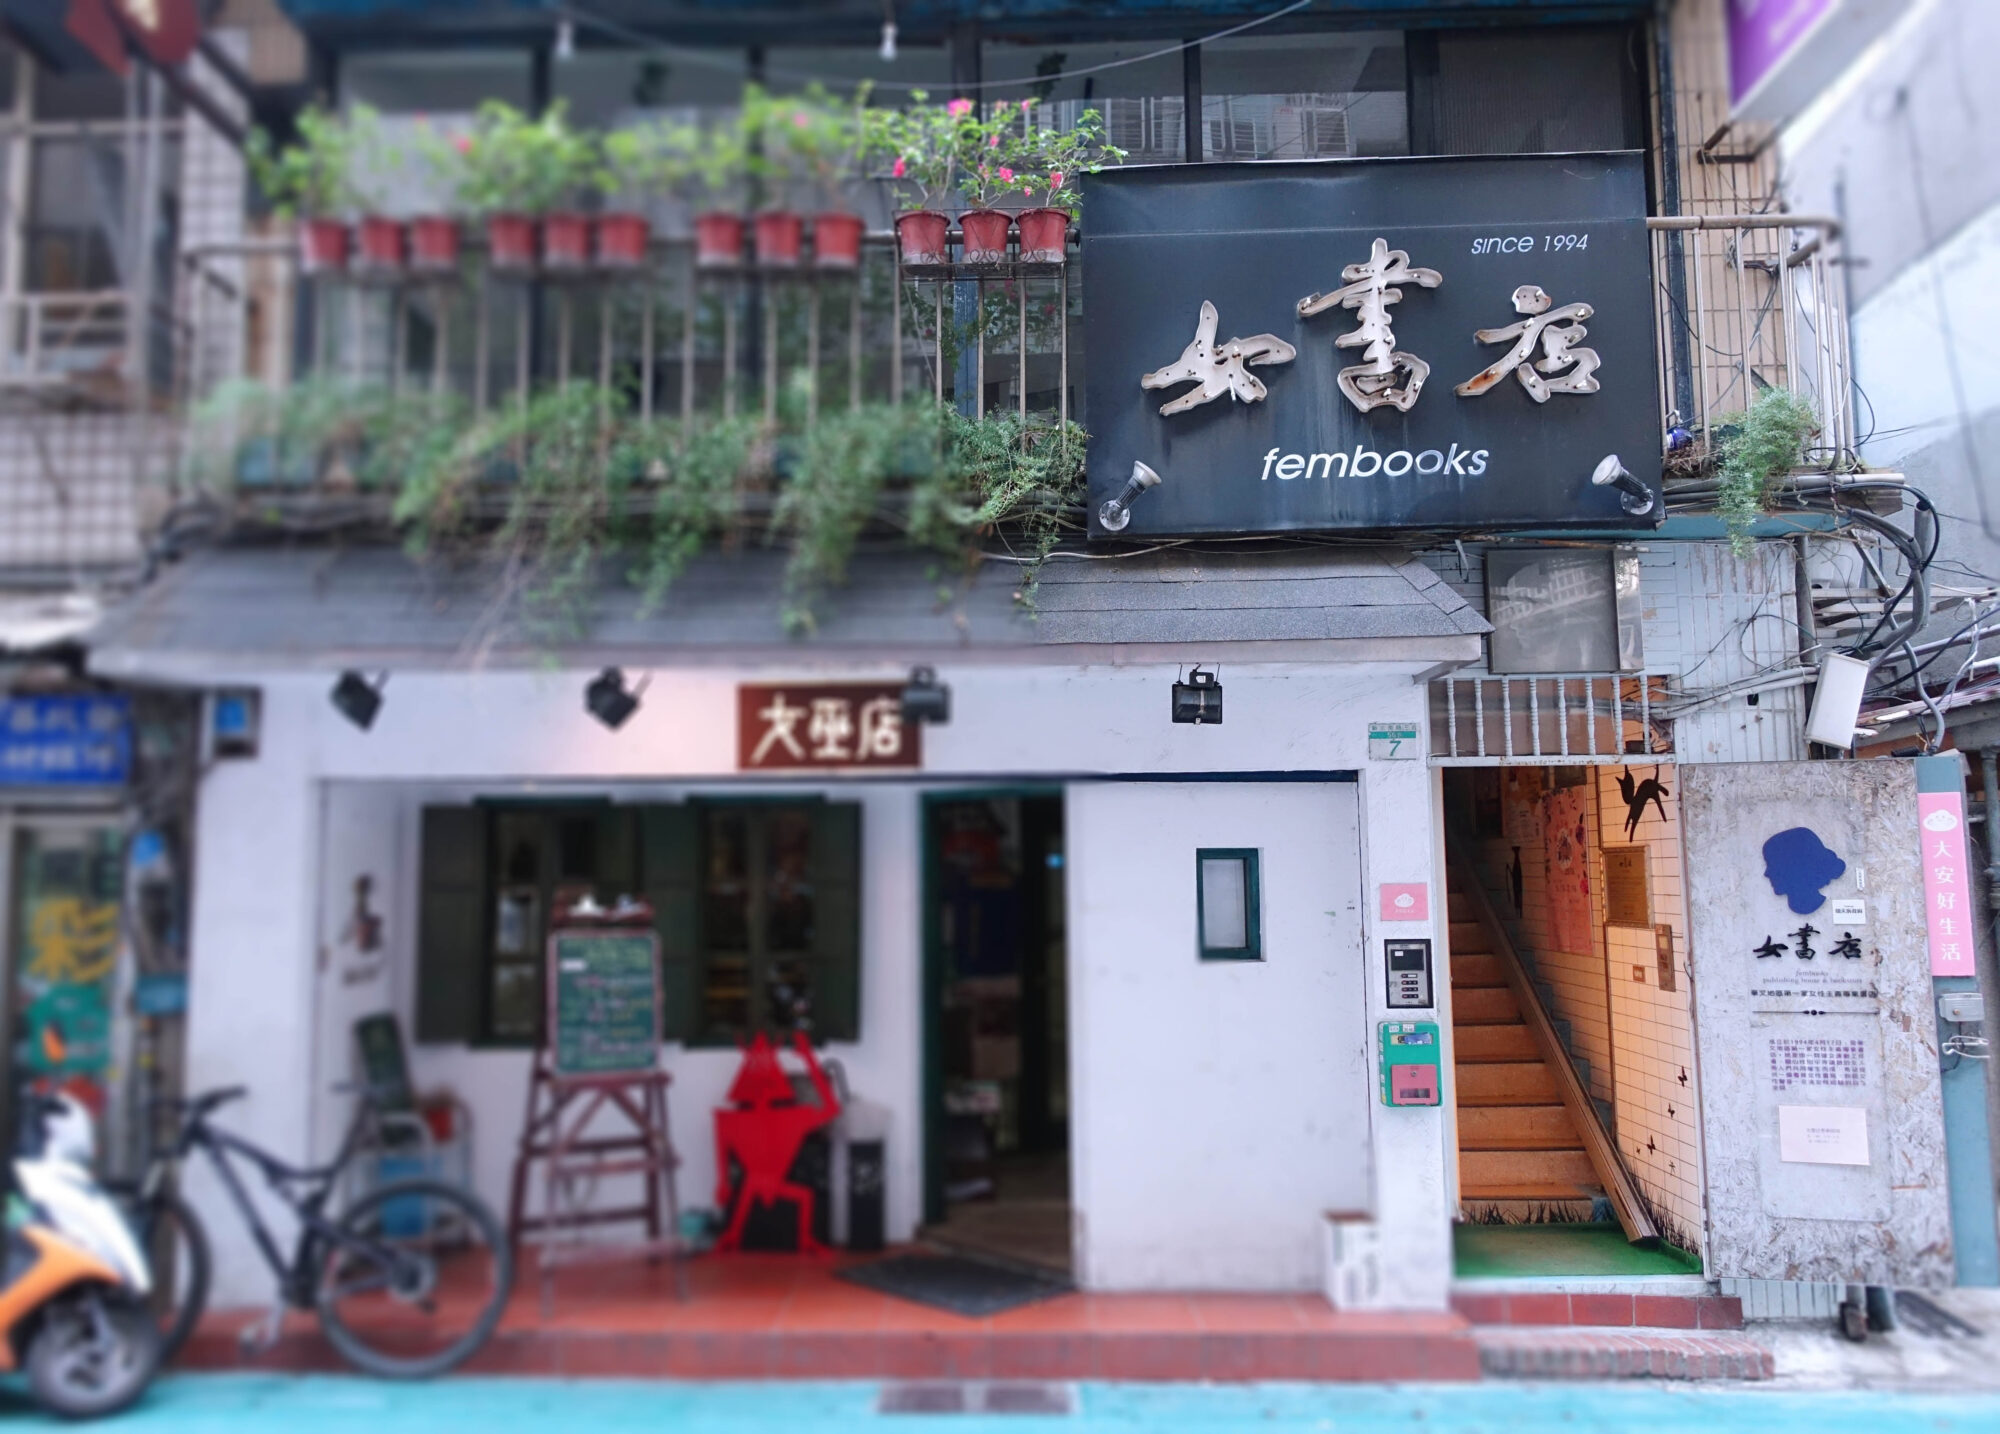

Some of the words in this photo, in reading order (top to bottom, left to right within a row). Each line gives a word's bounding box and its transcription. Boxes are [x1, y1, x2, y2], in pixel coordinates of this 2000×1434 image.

[1470, 233, 1534, 255] since
[1543, 233, 1588, 252] 1994
[1261, 443, 1490, 480] fembooks
[1389, 740, 1402, 757] 7
[1932, 839, 1961, 962] 大安好生活
[1752, 922, 1863, 960] 女書店
